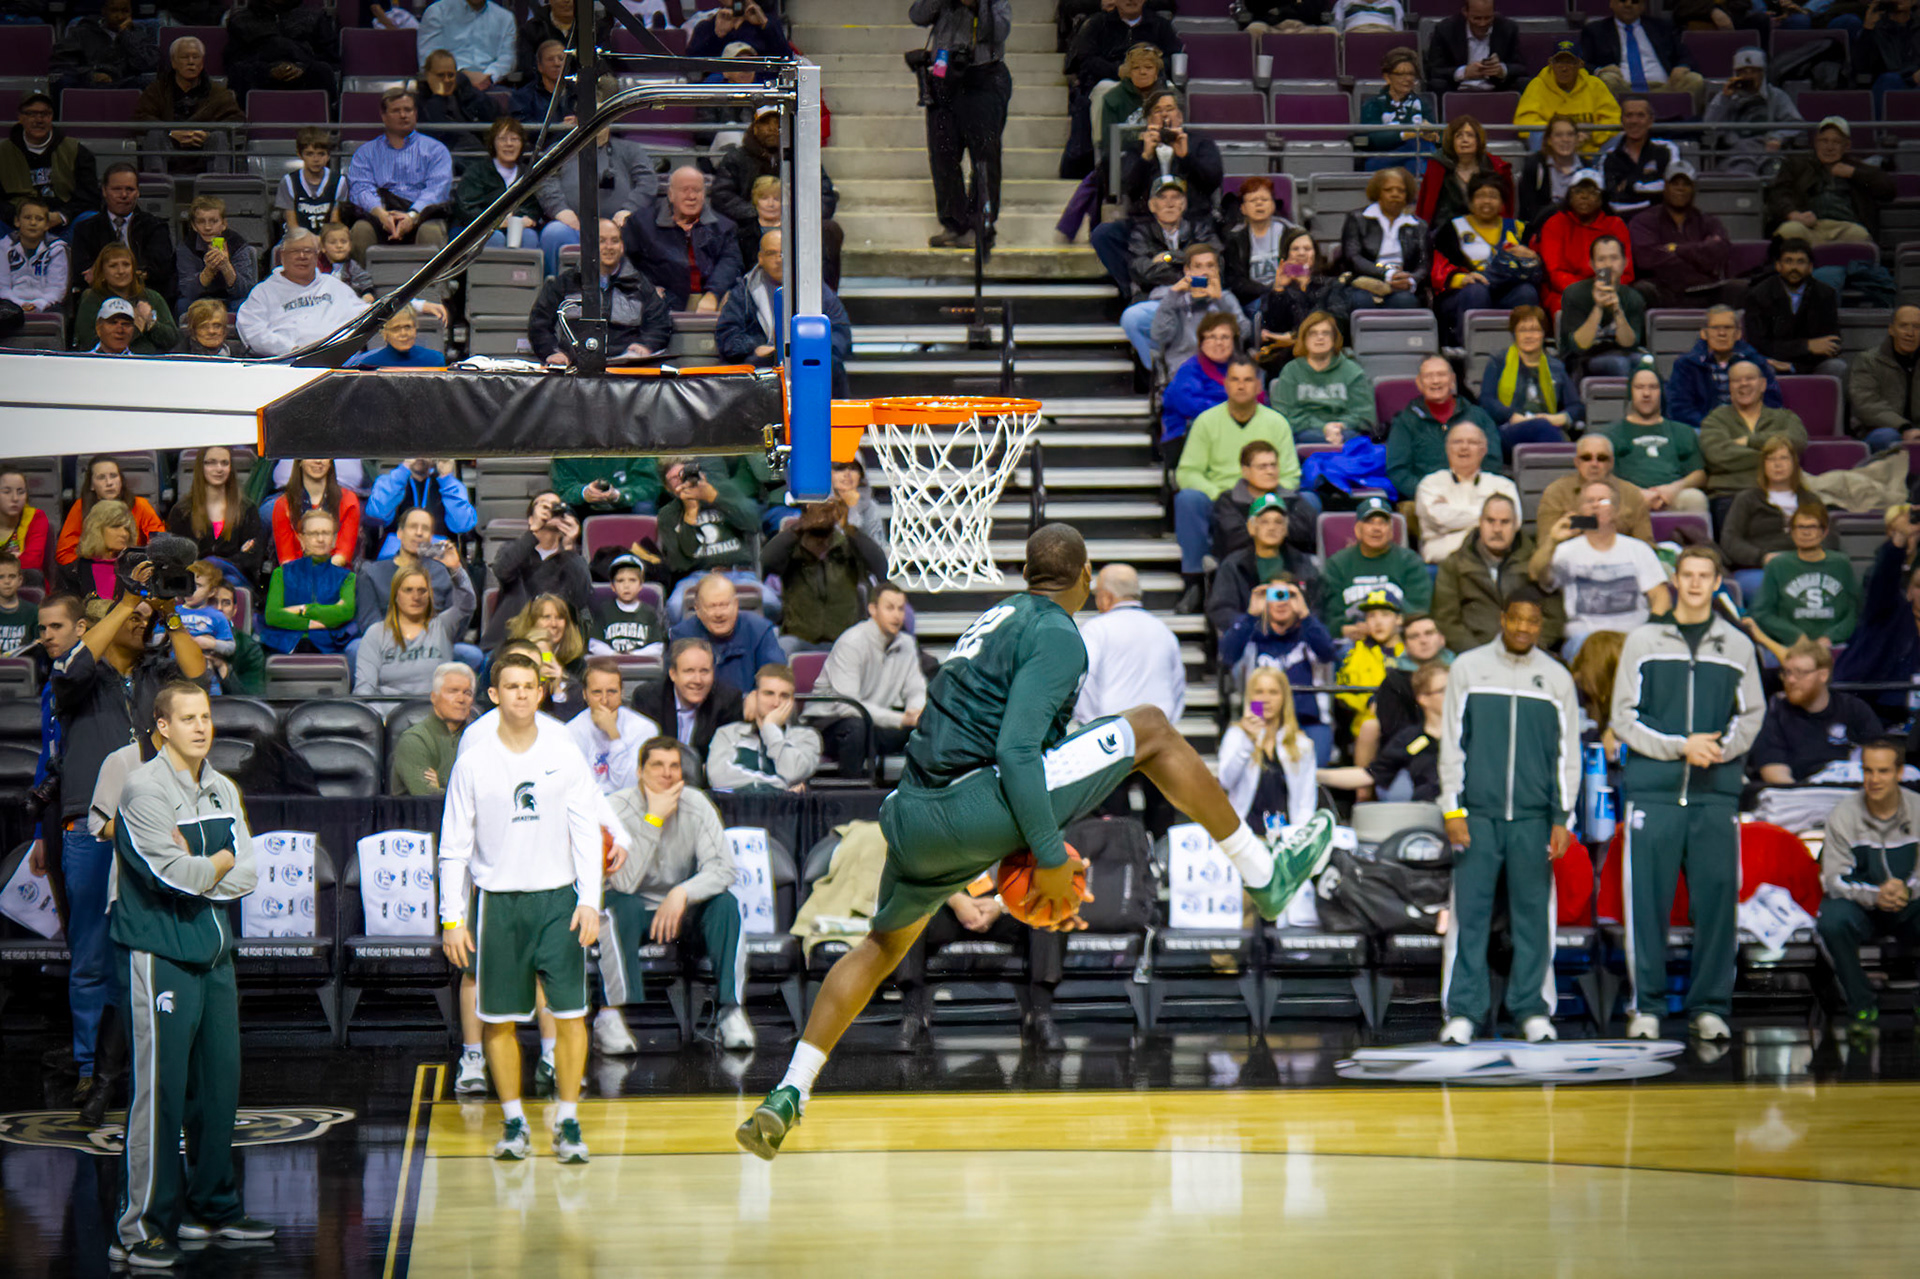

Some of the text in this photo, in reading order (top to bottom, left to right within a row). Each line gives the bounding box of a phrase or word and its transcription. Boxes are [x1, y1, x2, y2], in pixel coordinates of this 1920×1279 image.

[1806, 589, 1823, 609] S
[603, 622, 648, 640] MICHIGAN
[238, 947, 314, 956] THE ROAD TO THE FINAL FOUR
[356, 947, 431, 956] THE ROAD TO THE FINAL FOUR
